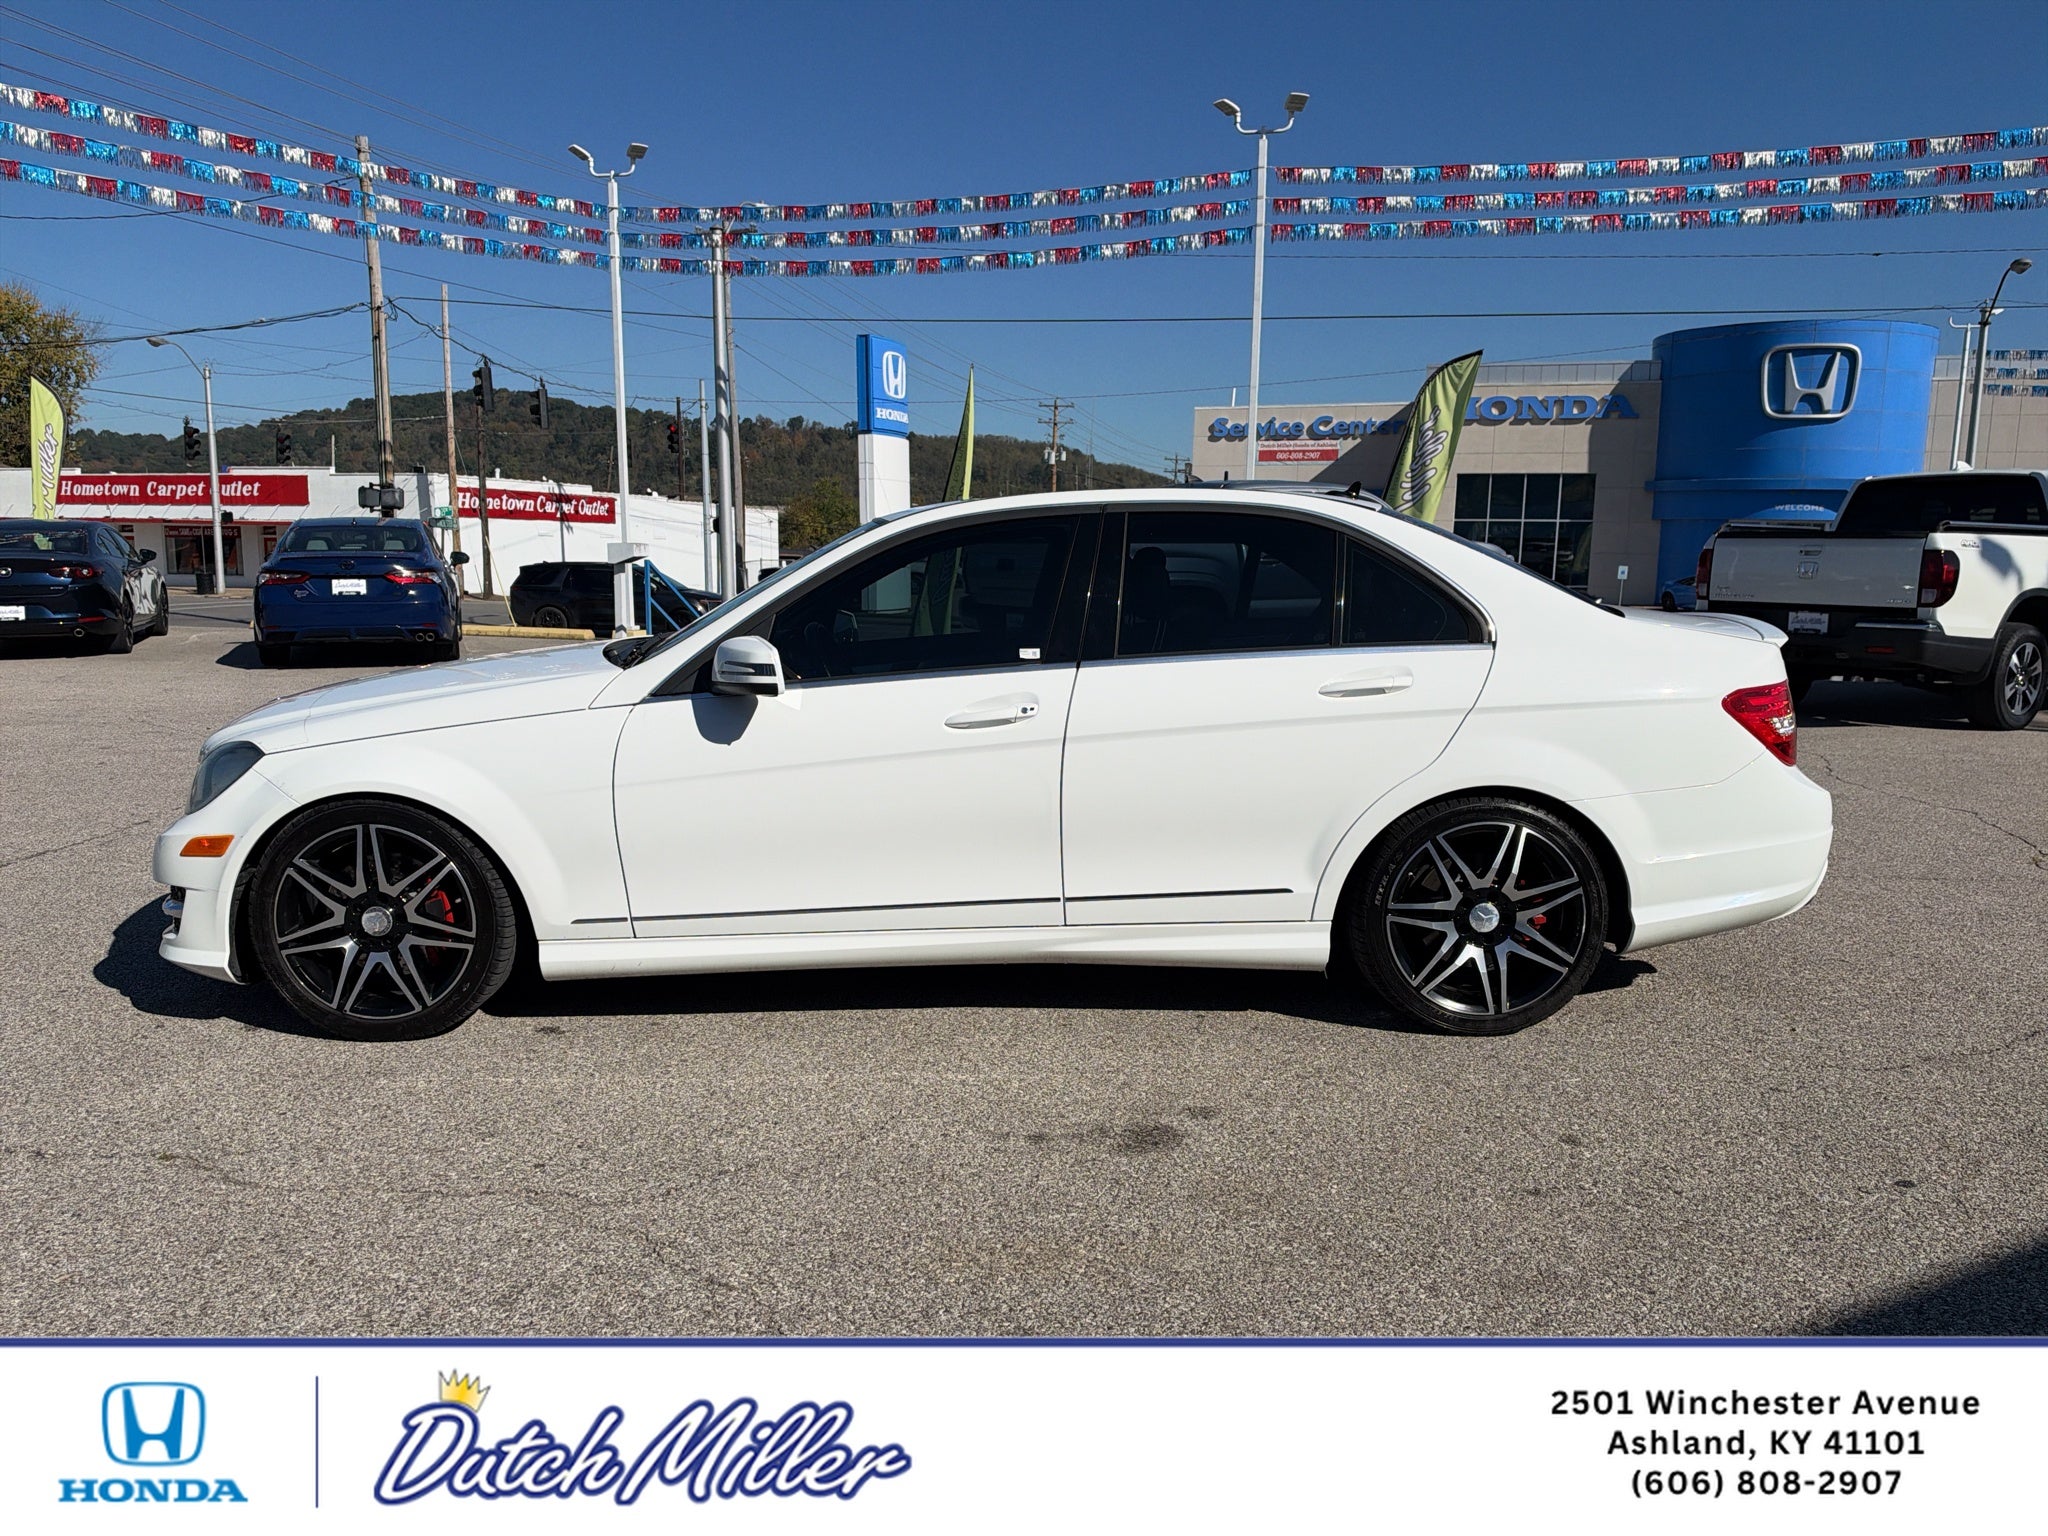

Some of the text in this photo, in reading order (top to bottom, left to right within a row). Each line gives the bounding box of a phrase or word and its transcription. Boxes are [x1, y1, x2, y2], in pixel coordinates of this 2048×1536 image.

[61, 480, 261, 499] Hometown Carpet utlet
[536, 495, 576, 518] Carpet
[578, 499, 609, 516] Outlet
[1775, 504, 1824, 512] WELCOME
